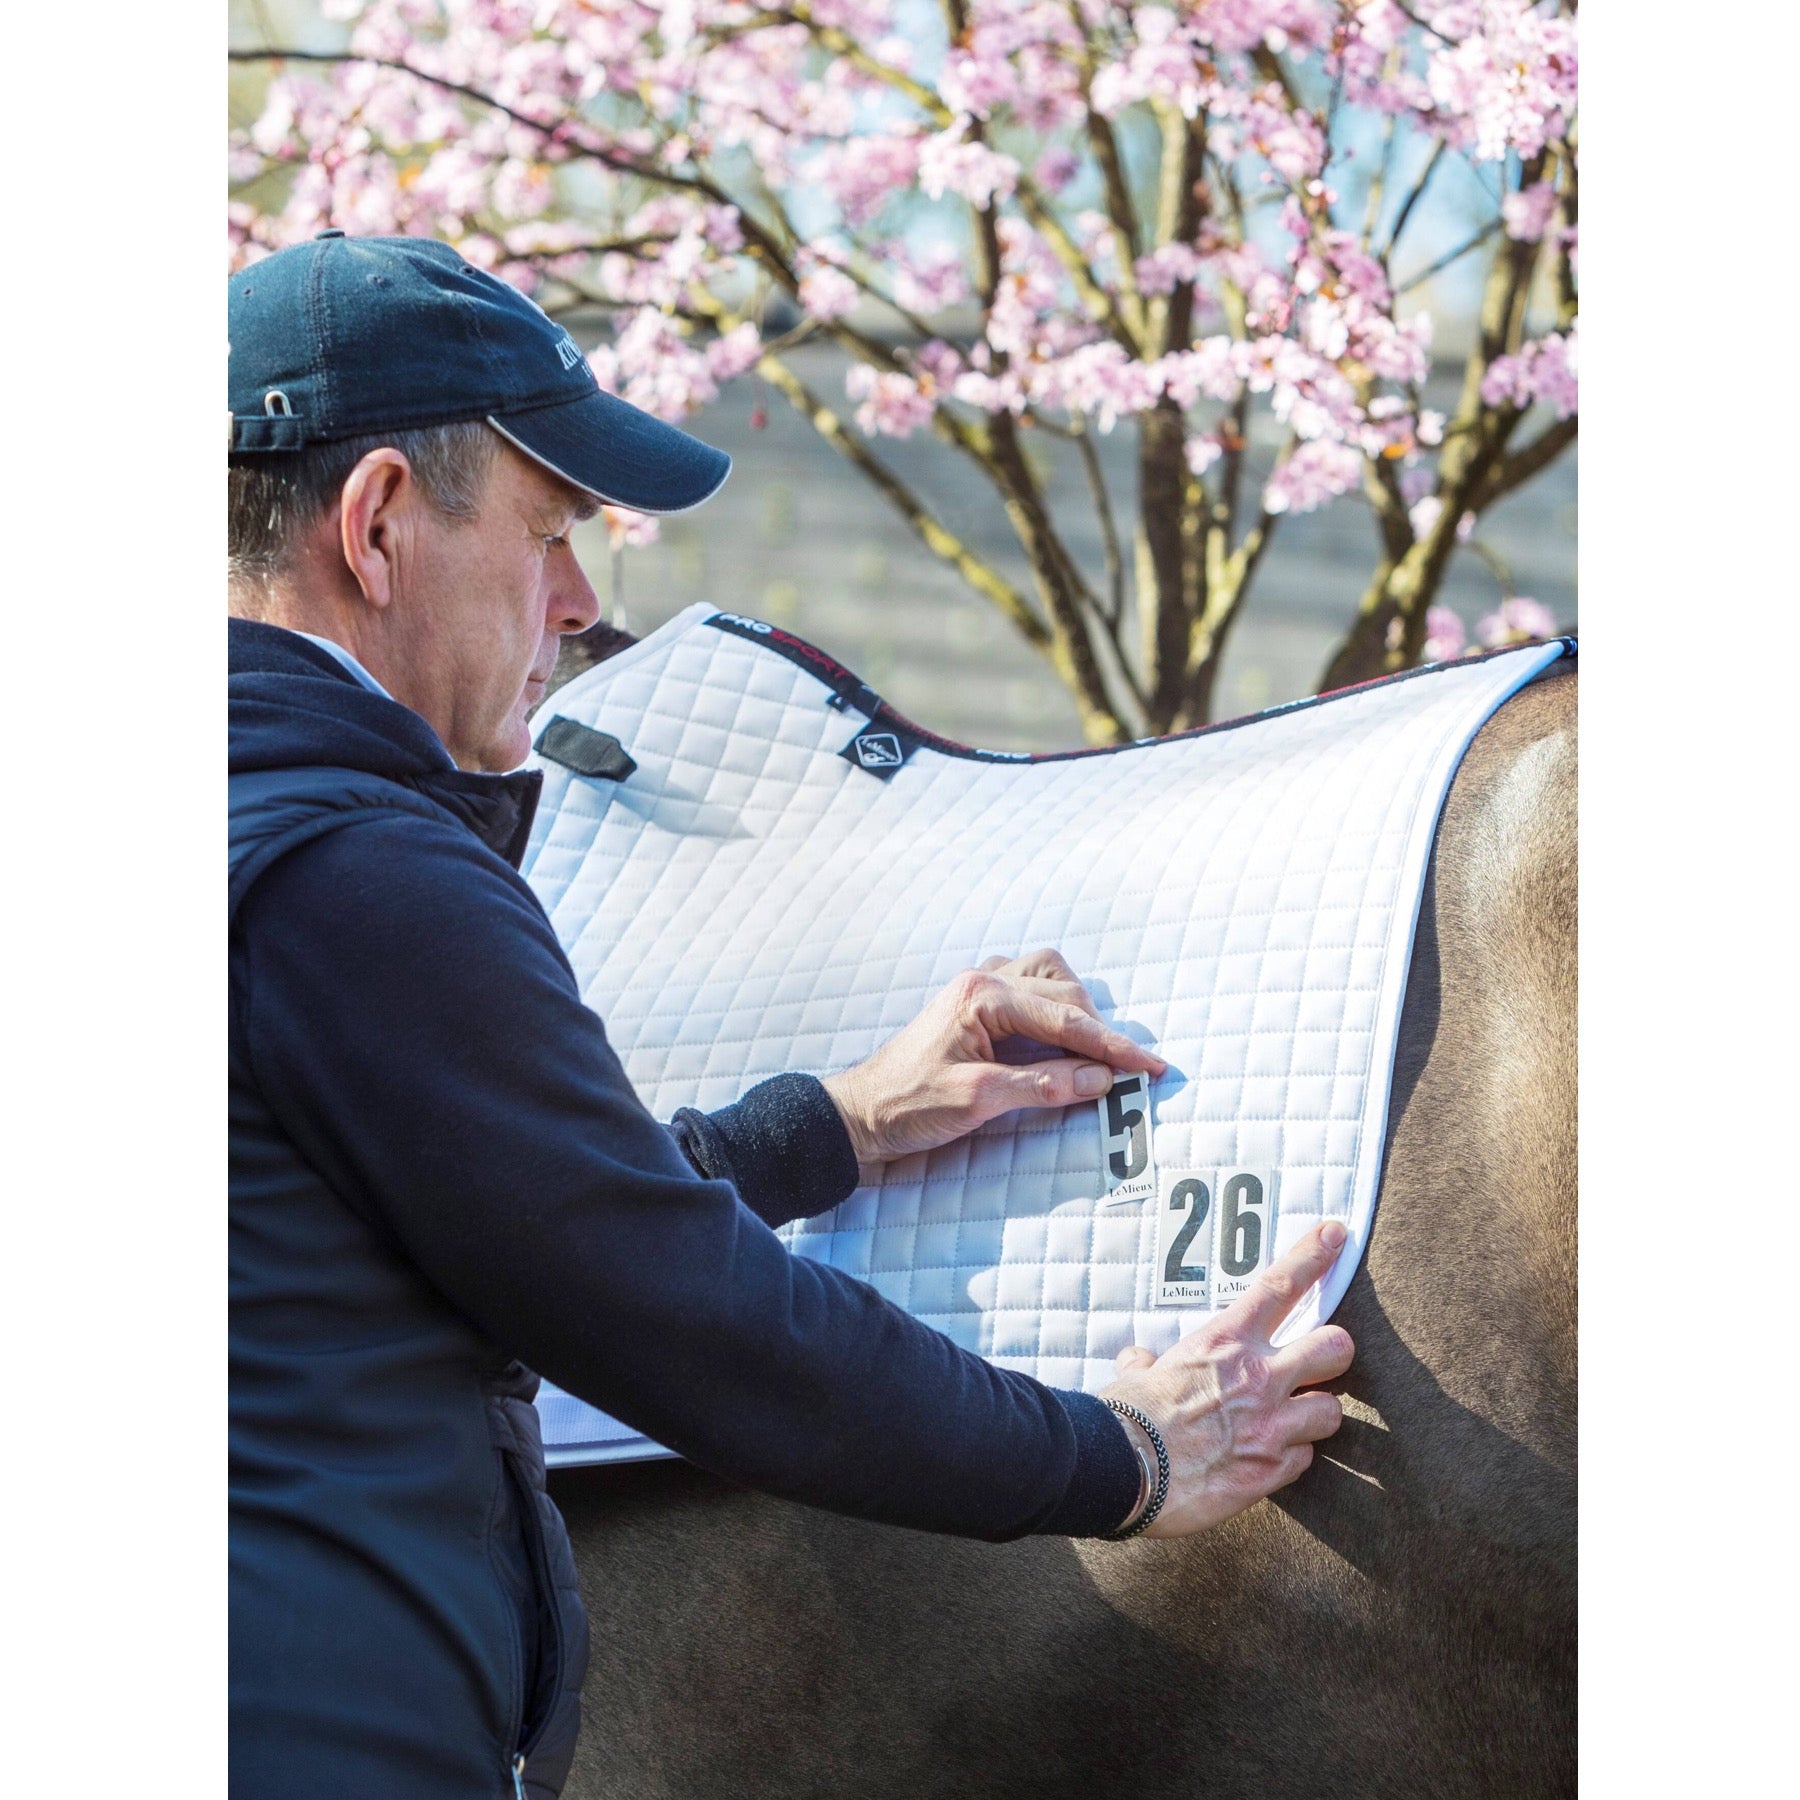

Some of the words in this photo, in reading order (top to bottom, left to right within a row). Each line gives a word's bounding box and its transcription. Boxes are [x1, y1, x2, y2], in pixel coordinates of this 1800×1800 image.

[1105, 1077, 1148, 1180] 5
[1110, 1183, 1153, 1198] LeMieux
[1162, 1287, 1206, 1298] LeMieux
